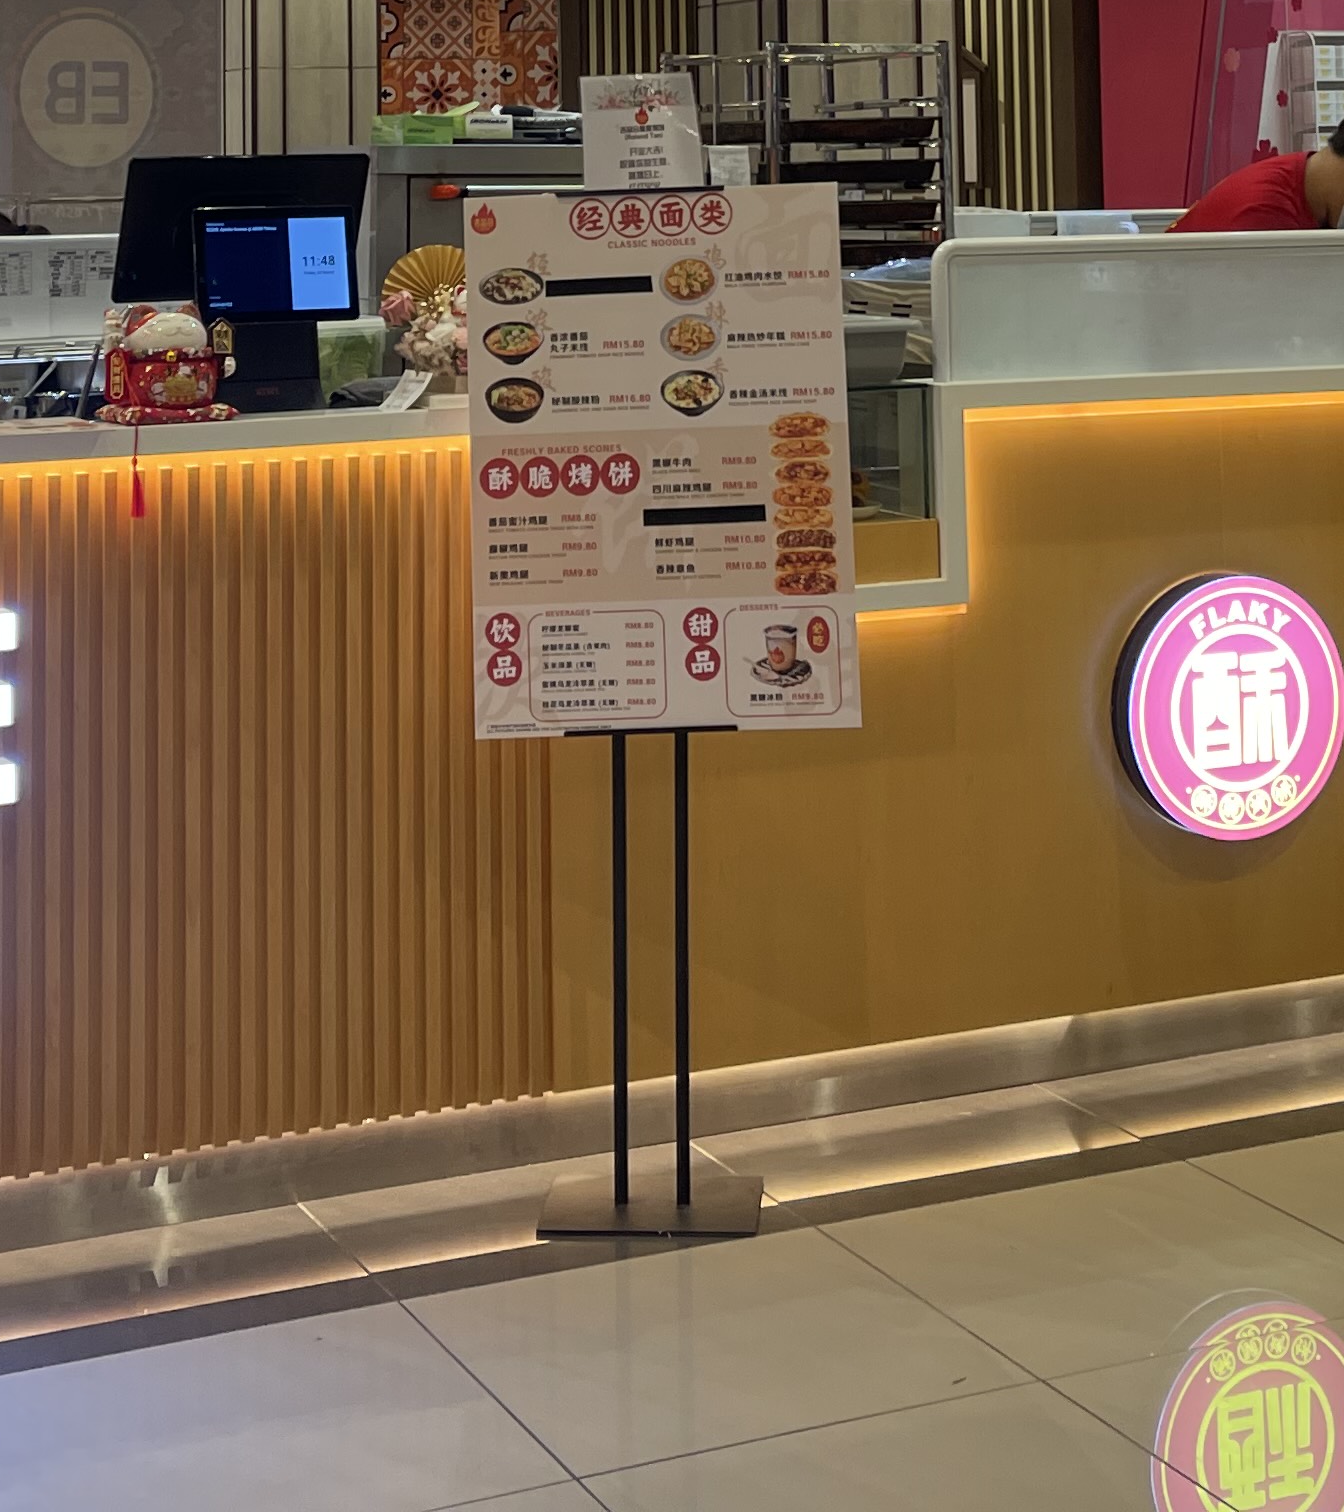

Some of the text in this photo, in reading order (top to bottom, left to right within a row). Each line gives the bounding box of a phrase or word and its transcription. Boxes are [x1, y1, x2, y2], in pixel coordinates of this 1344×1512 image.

[575, 199, 726, 232] 经典面类
[607, 238, 696, 249] CLASSIC NOODLES
[302, 255, 336, 267] 11:48
[788, 269, 830, 279] RM15.80
[790, 330, 833, 340] RM15.80
[602, 339, 645, 350] RM15.80
[792, 386, 835, 397] RM15.80
[609, 393, 652, 404] RM16.80
[501, 444, 622, 457] FRESHLY BAKED SCONES
[721, 456, 757, 466] RM9.80
[487, 460, 633, 491] 酥脆烤饼
[722, 481, 758, 491] RM9.80
[724, 534, 766, 545] RM10.80
[561, 541, 598, 552] RM9.80
[725, 560, 767, 571] RM10.80
[562, 568, 599, 578] RM9.80
[545, 609, 591, 617] BEVERAGES
[739, 604, 778, 612] DESSERTS
[1189, 599, 1292, 640] FLAKY
[490, 618, 517, 680] 饮品
[689, 613, 715, 675] 甜品
[1191, 651, 1289, 770] 酥
